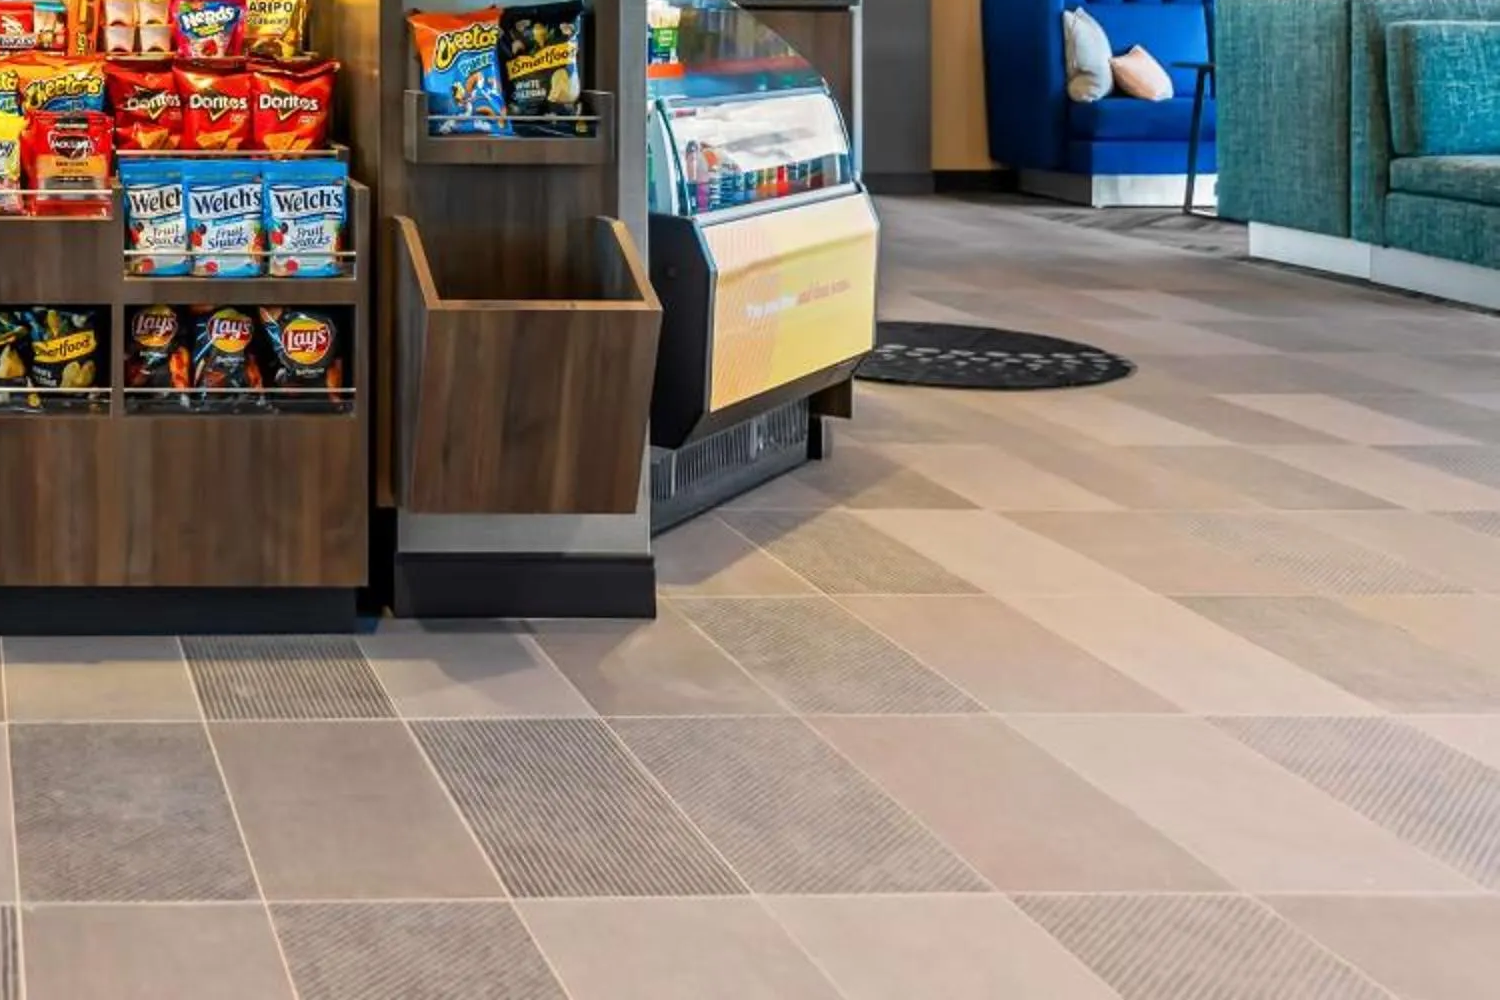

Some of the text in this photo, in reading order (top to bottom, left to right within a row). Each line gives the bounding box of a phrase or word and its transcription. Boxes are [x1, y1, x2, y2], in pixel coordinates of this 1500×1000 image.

[181, 5, 235, 28] Nerds
[436, 26, 499, 68] Cheetos
[127, 92, 181, 110] Doritos
[190, 94, 247, 110] Doritos
[260, 94, 318, 111] Doritos
[131, 187, 181, 213] Welch
[194, 187, 261, 215] Welch's
[275, 189, 343, 213] Welch's
[288, 329, 327, 353] Lay's
